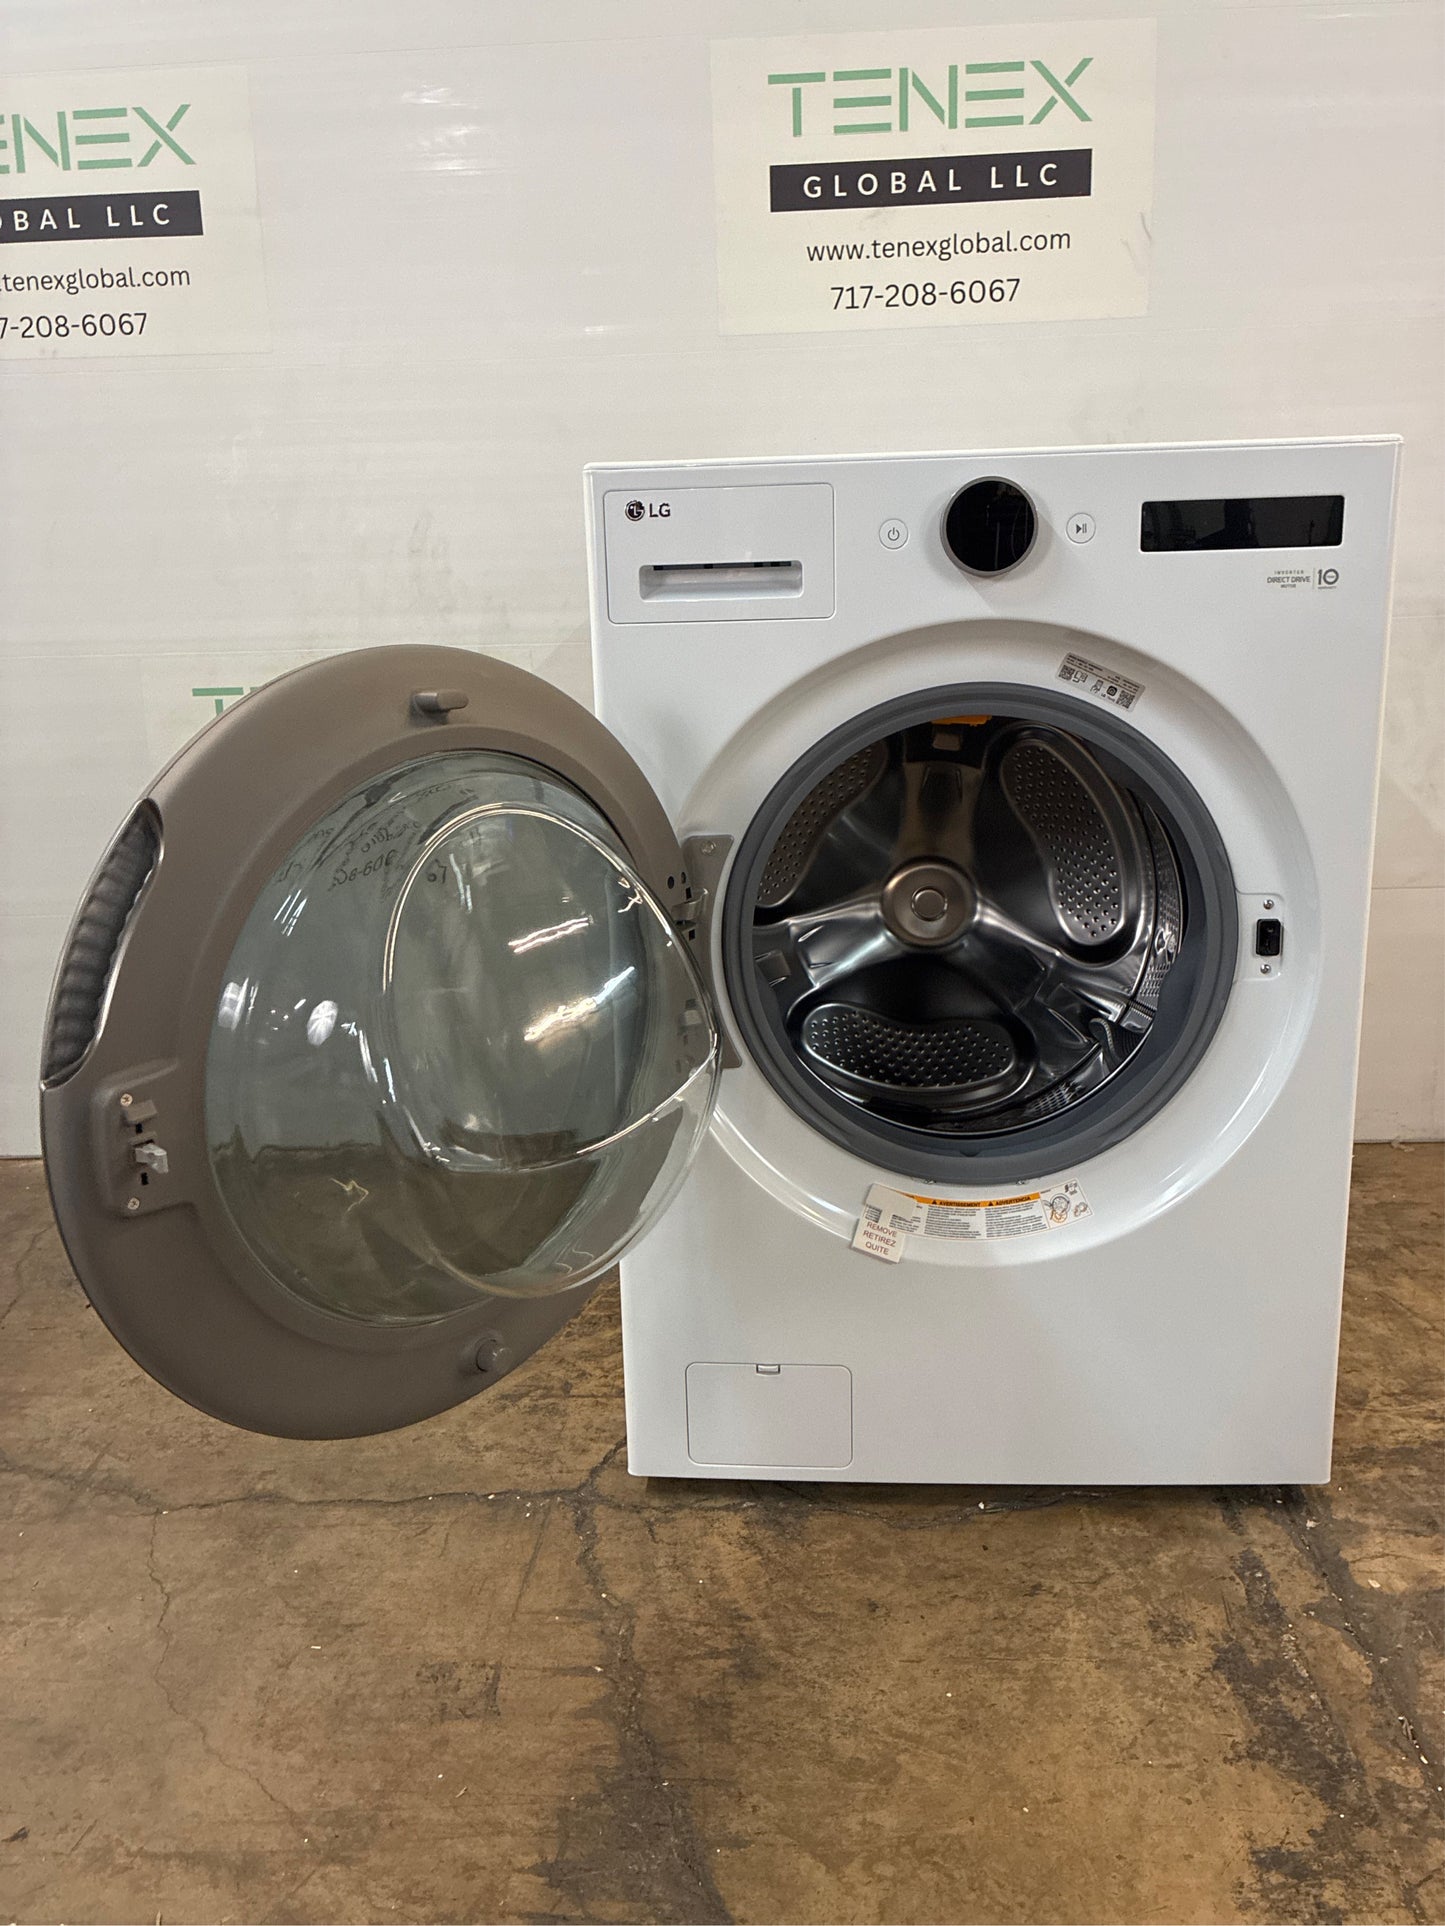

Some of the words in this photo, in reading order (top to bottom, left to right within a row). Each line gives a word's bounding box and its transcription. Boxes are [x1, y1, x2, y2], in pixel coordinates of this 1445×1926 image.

[768, 58, 1094, 137] TENEX
[0, 104, 196, 174] NEX
[803, 169, 961, 198] GLOBAL
[990, 163, 1057, 189] LLC
[0, 208, 81, 231] BAL
[106, 203, 170, 227] LLC
[807, 230, 1071, 261] www.tenexglobal.com
[830, 278, 1020, 310] 717-208-6067
[649, 503, 671, 517] LG
[1291, 575, 1311, 583] DRIVE
[995, 1196, 1031, 1206] ADVERTENCIA
[863, 1230, 897, 1247] RETIREZ
[866, 1221, 898, 1238] REMOVE
[865, 1241, 889, 1255] QUITE
